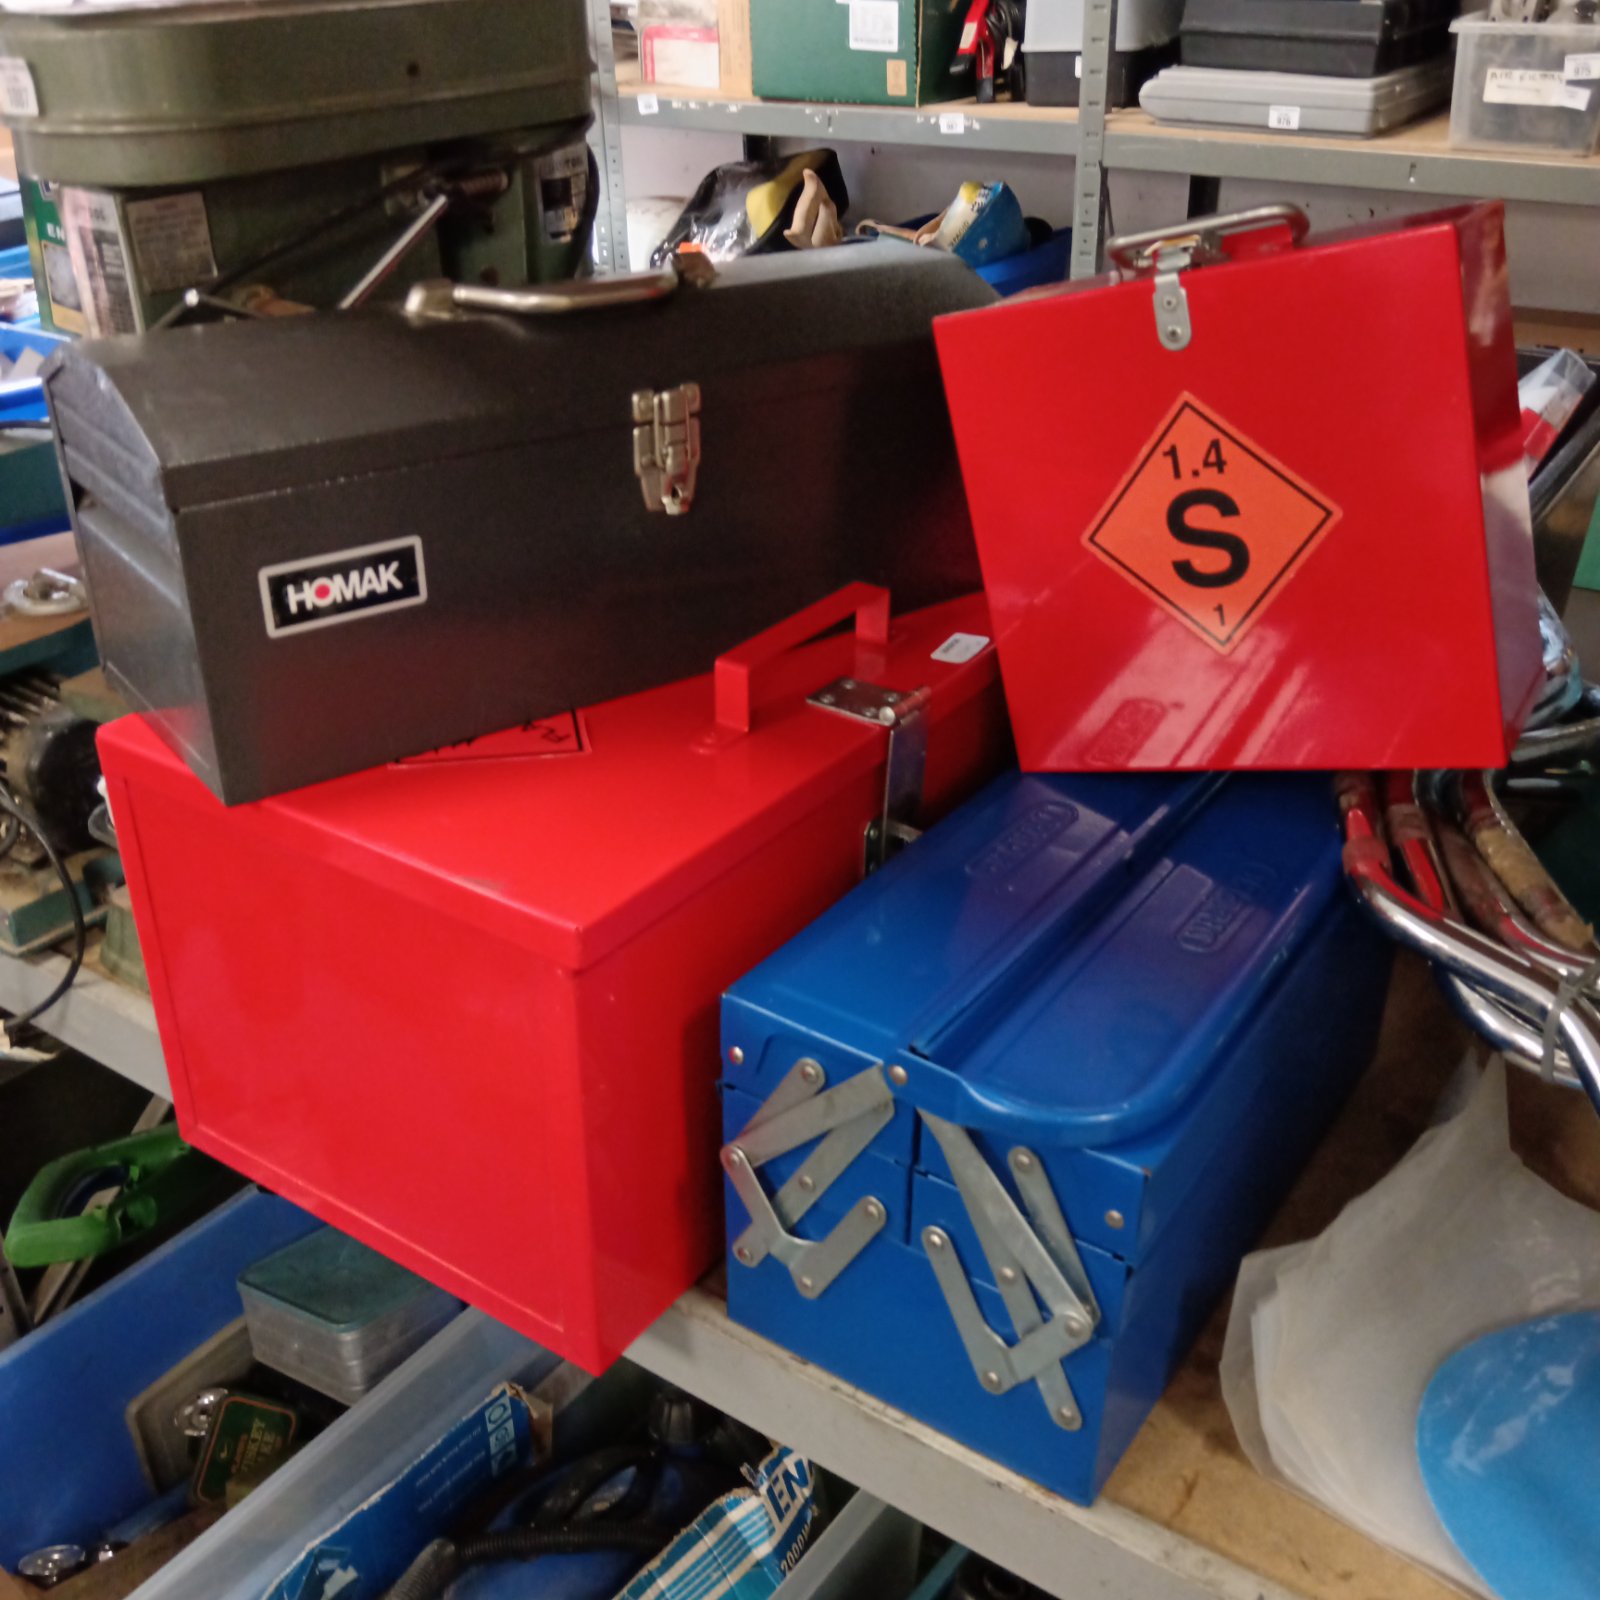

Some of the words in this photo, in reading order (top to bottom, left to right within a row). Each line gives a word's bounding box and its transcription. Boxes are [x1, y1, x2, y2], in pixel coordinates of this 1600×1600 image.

[1163, 438, 1227, 480] 1.4
[1166, 487, 1250, 589] S
[286, 562, 403, 613] HOMAK
[1212, 603, 1226, 627] 1
